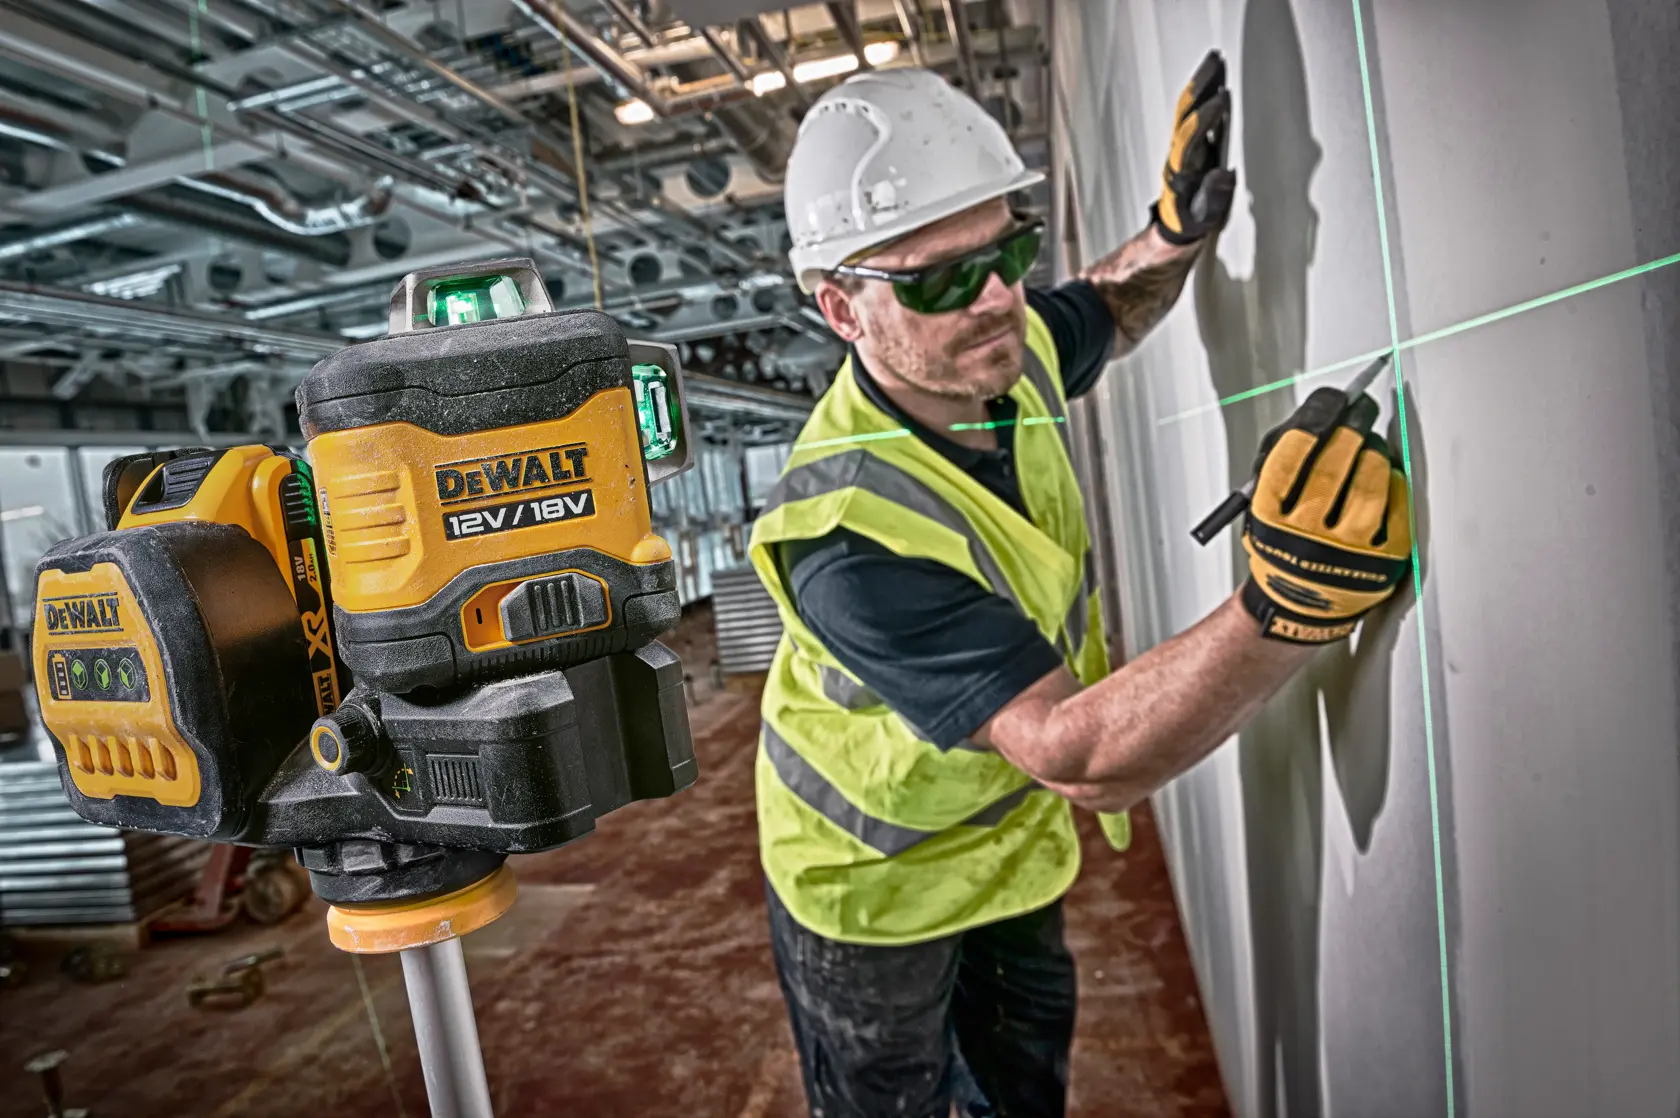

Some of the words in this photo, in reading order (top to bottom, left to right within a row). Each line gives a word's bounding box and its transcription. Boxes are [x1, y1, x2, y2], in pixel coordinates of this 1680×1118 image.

[294, 555, 306, 582] 18V
[1298, 559, 1388, 583] GUARANTEED
[301, 610, 331, 660] XR
